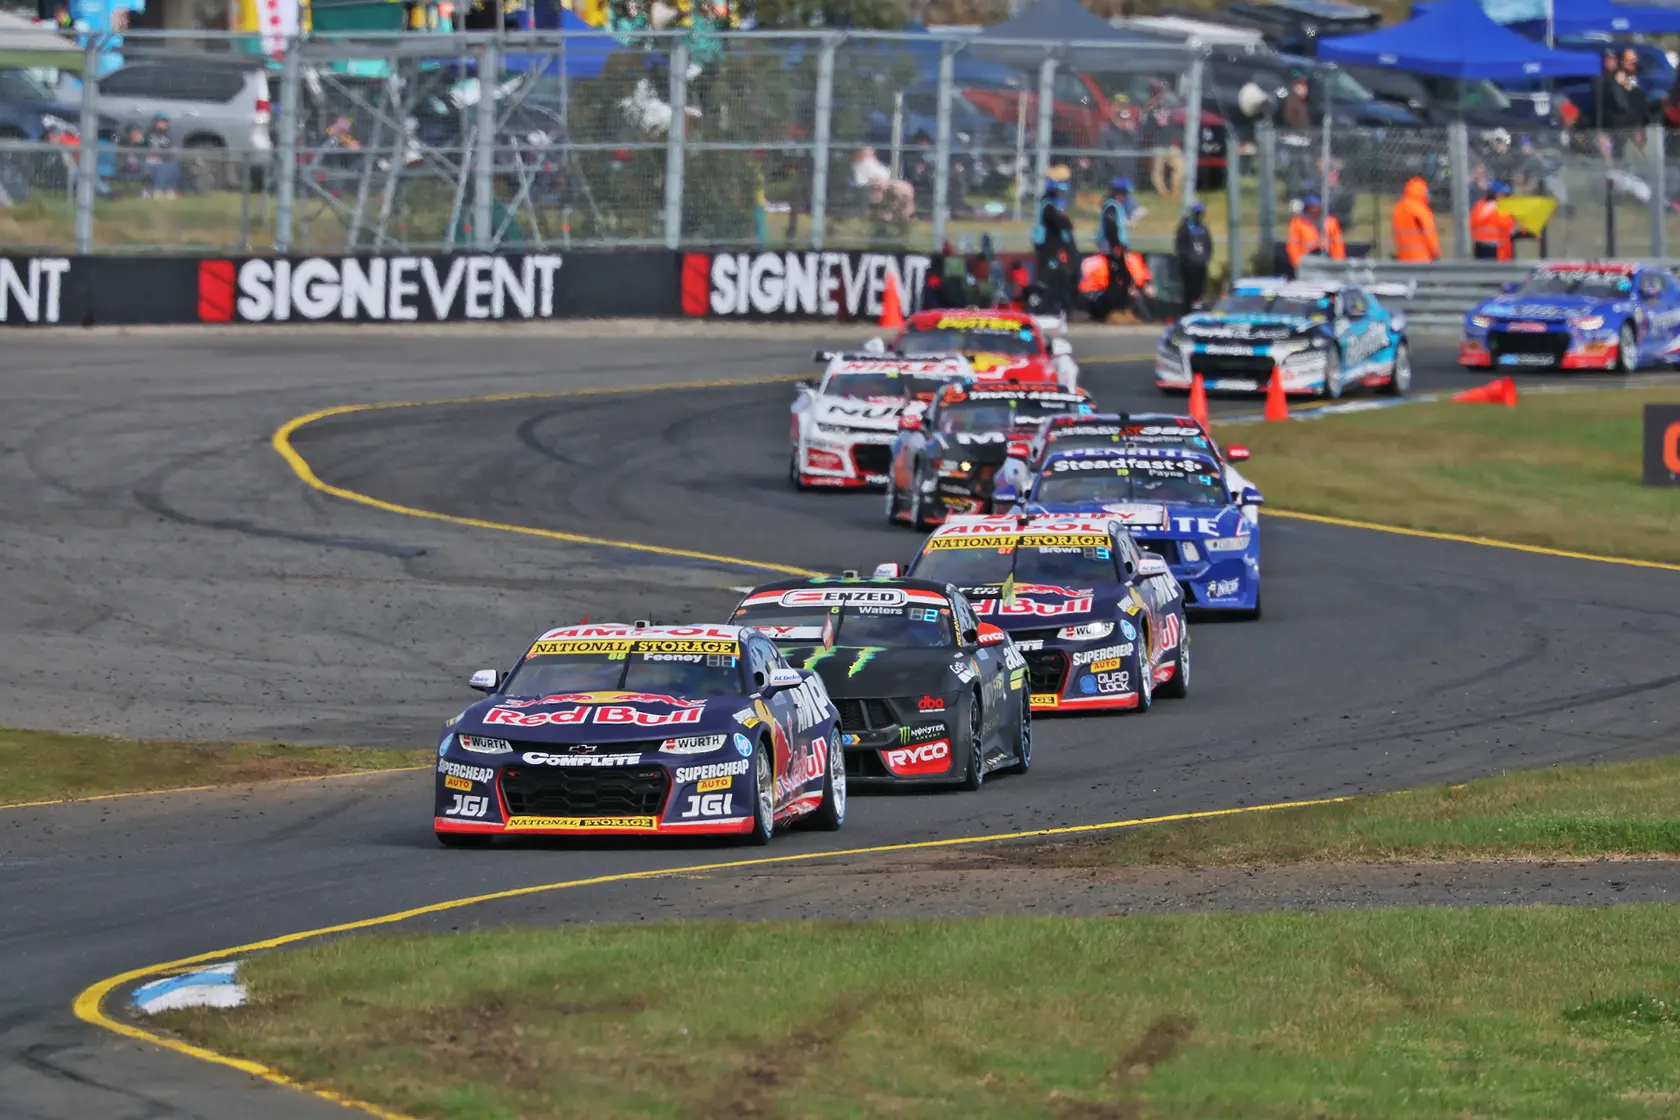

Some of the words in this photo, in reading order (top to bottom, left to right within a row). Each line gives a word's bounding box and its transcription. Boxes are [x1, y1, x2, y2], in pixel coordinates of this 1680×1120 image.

[238, 256, 562, 320] SIGNEVENT
[710, 252, 931, 316] SIGNEVENT
[1054, 458, 1175, 471] Steadfast
[940, 523, 1103, 534] AMPOL
[931, 536, 1013, 549] NATIONAL
[1024, 535, 1105, 546] STORAGE
[1039, 546, 1082, 554] Brown
[823, 592, 895, 602] ENZED
[830, 606, 840, 614] 6
[859, 605, 903, 615] Waters
[547, 627, 733, 639] AMPOL
[977, 632, 1005, 643] RYCO
[533, 641, 628, 653] NATIONAL
[637, 641, 734, 653] STORAGE
[607, 651, 627, 661] 88
[643, 652, 704, 664] Feeney
[1073, 643, 1134, 666] SUPERCHEAP
[1094, 660, 1117, 670] AUTO
[1097, 671, 1129, 683] QUAD
[1098, 682, 1130, 693] LOCK
[918, 695, 945, 710] dba
[482, 705, 593, 728] Red
[592, 704, 705, 727] Bull
[911, 724, 946, 737] MONSTER
[471, 736, 507, 750] WÜRTH
[678, 734, 720, 749] WÜRTH
[522, 751, 641, 766] COMPLETE
[887, 742, 948, 767] RYCO
[437, 757, 494, 784] SUPERCHEAP
[675, 758, 750, 784] SUPERCHEAP
[447, 778, 470, 789] AUTO
[700, 778, 728, 790] AUTO
[445, 793, 489, 818] JGI
[681, 793, 733, 818] JGI
[509, 819, 577, 827] NATIONAL
[583, 818, 652, 827] STORAGE
